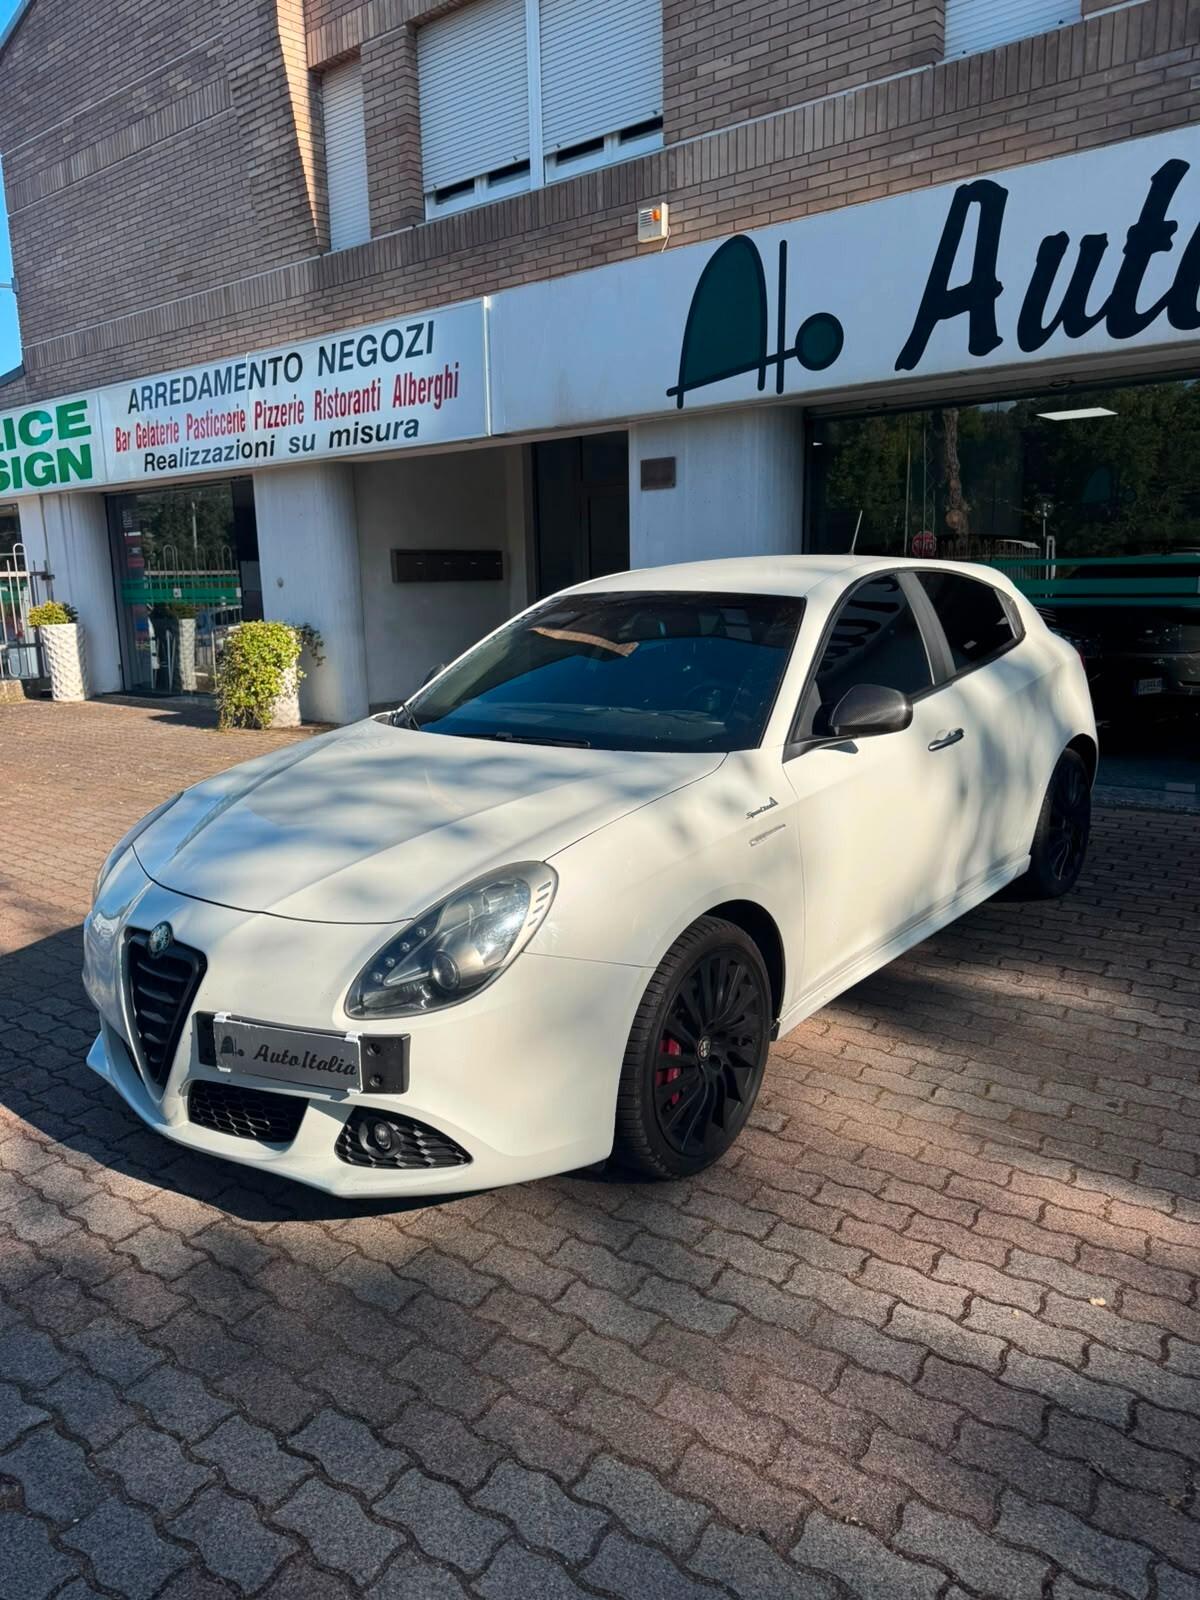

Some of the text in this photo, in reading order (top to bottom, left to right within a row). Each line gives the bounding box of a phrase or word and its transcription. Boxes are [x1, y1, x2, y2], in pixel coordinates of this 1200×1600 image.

[128, 320, 434, 414] ARREDAMENTO NEGOZI
[0, 400, 92, 452] ICE
[115, 362, 459, 453] Bar Gelaterie Pasticcerie Pizzerie Ristoranti Alberghi
[144, 418, 419, 472] Realizzazioni su misura
